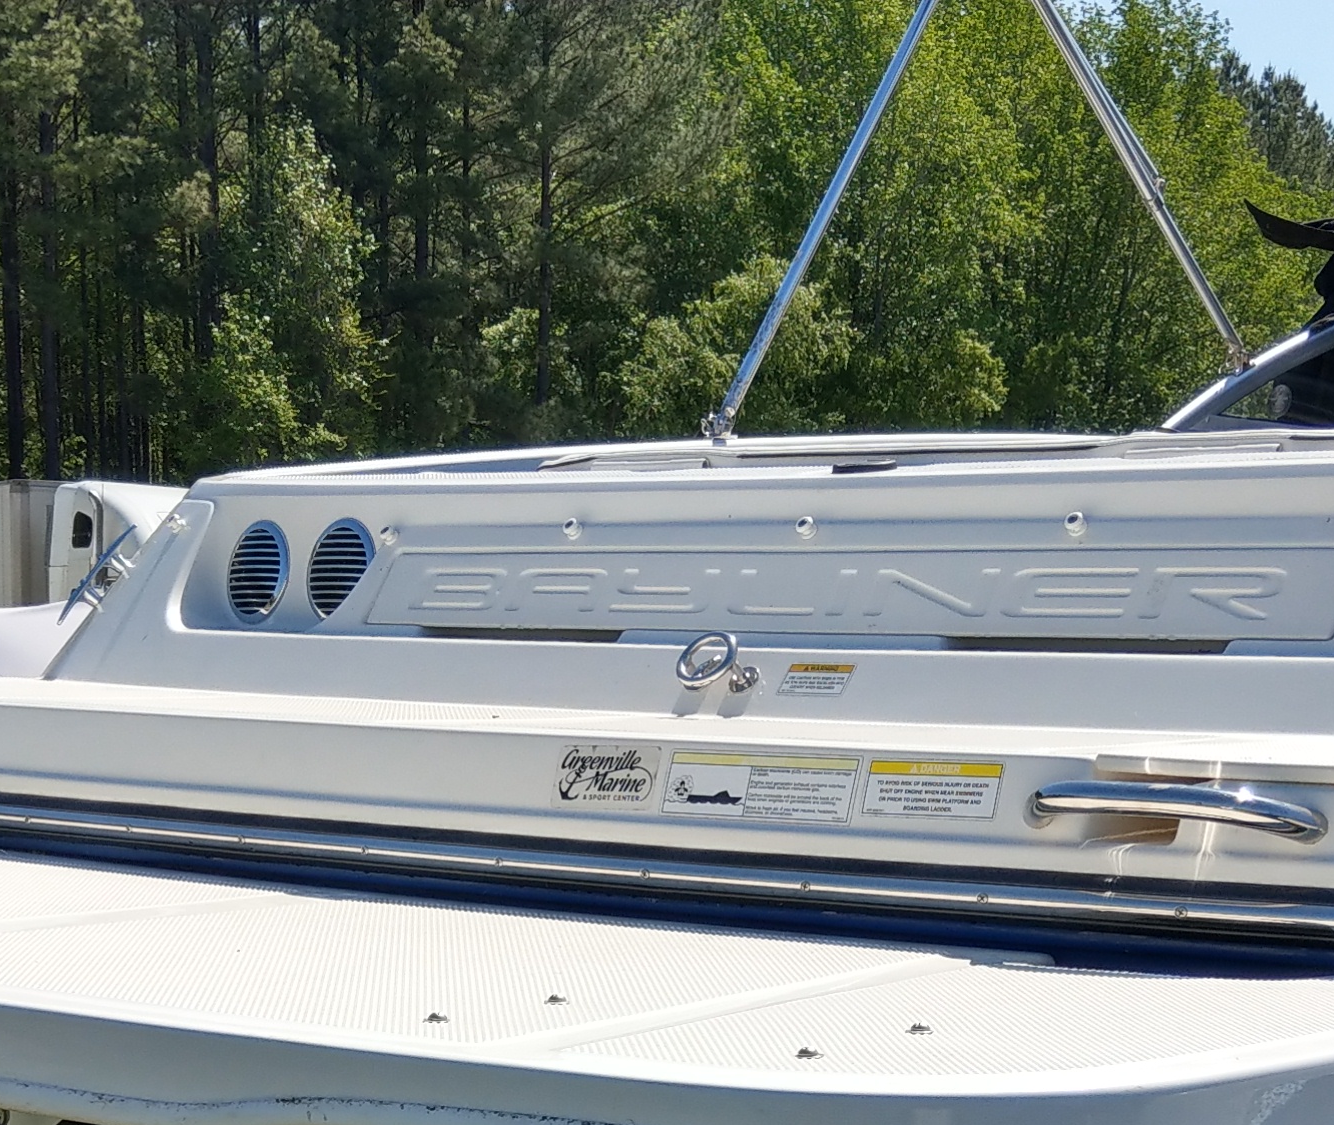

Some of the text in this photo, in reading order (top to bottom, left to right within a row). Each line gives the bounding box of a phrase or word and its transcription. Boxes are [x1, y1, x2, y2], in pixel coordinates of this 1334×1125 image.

[408, 566, 1287, 620] BAYLINER
[561, 748, 642, 770] Greenville
[920, 763, 961, 774] DANGER
[585, 770, 646, 792] Marine
